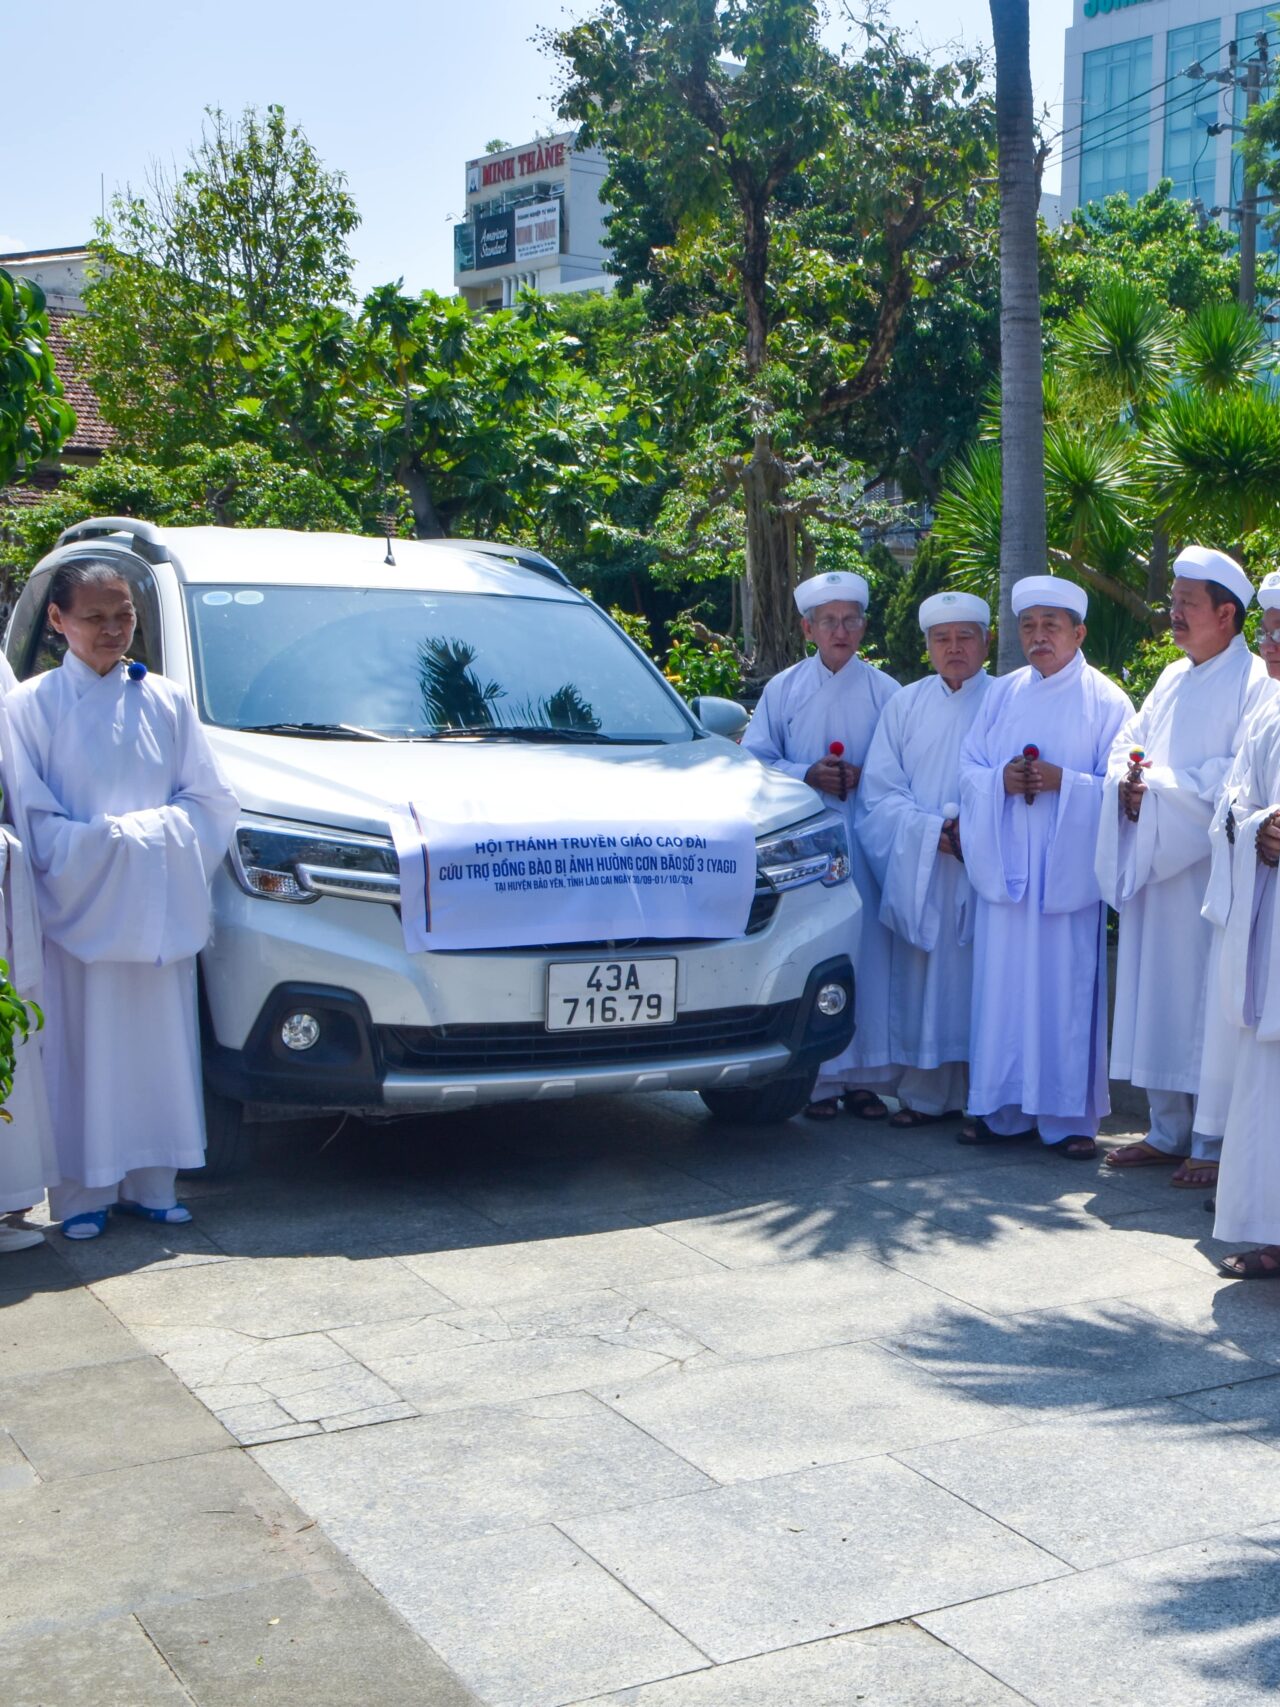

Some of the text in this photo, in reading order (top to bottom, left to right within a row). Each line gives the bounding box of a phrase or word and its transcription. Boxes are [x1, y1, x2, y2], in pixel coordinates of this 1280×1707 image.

[482, 157, 515, 186] MINH
[480, 228, 508, 243] American
[480, 239, 507, 258] Standard
[475, 833, 707, 857] HỘI THÁNH TRUYỀN GIÁO CAO ĐÀI
[439, 853, 737, 881] CỨU TRỢ ĐỒNG BÀO BỊ ẢNH HƯỞNG CƠN BÃO SỐ 3 (YAGI)
[494, 882, 507, 894] TẠI
[507, 879, 532, 893] HUYỆN
[533, 877, 548, 890] BẢO
[585, 876, 599, 887] LÀO
[600, 875, 612, 885] CAI
[613, 873, 631, 884] NGÀY
[586, 963, 640, 992] 43A
[563, 993, 662, 1025] 716.79
